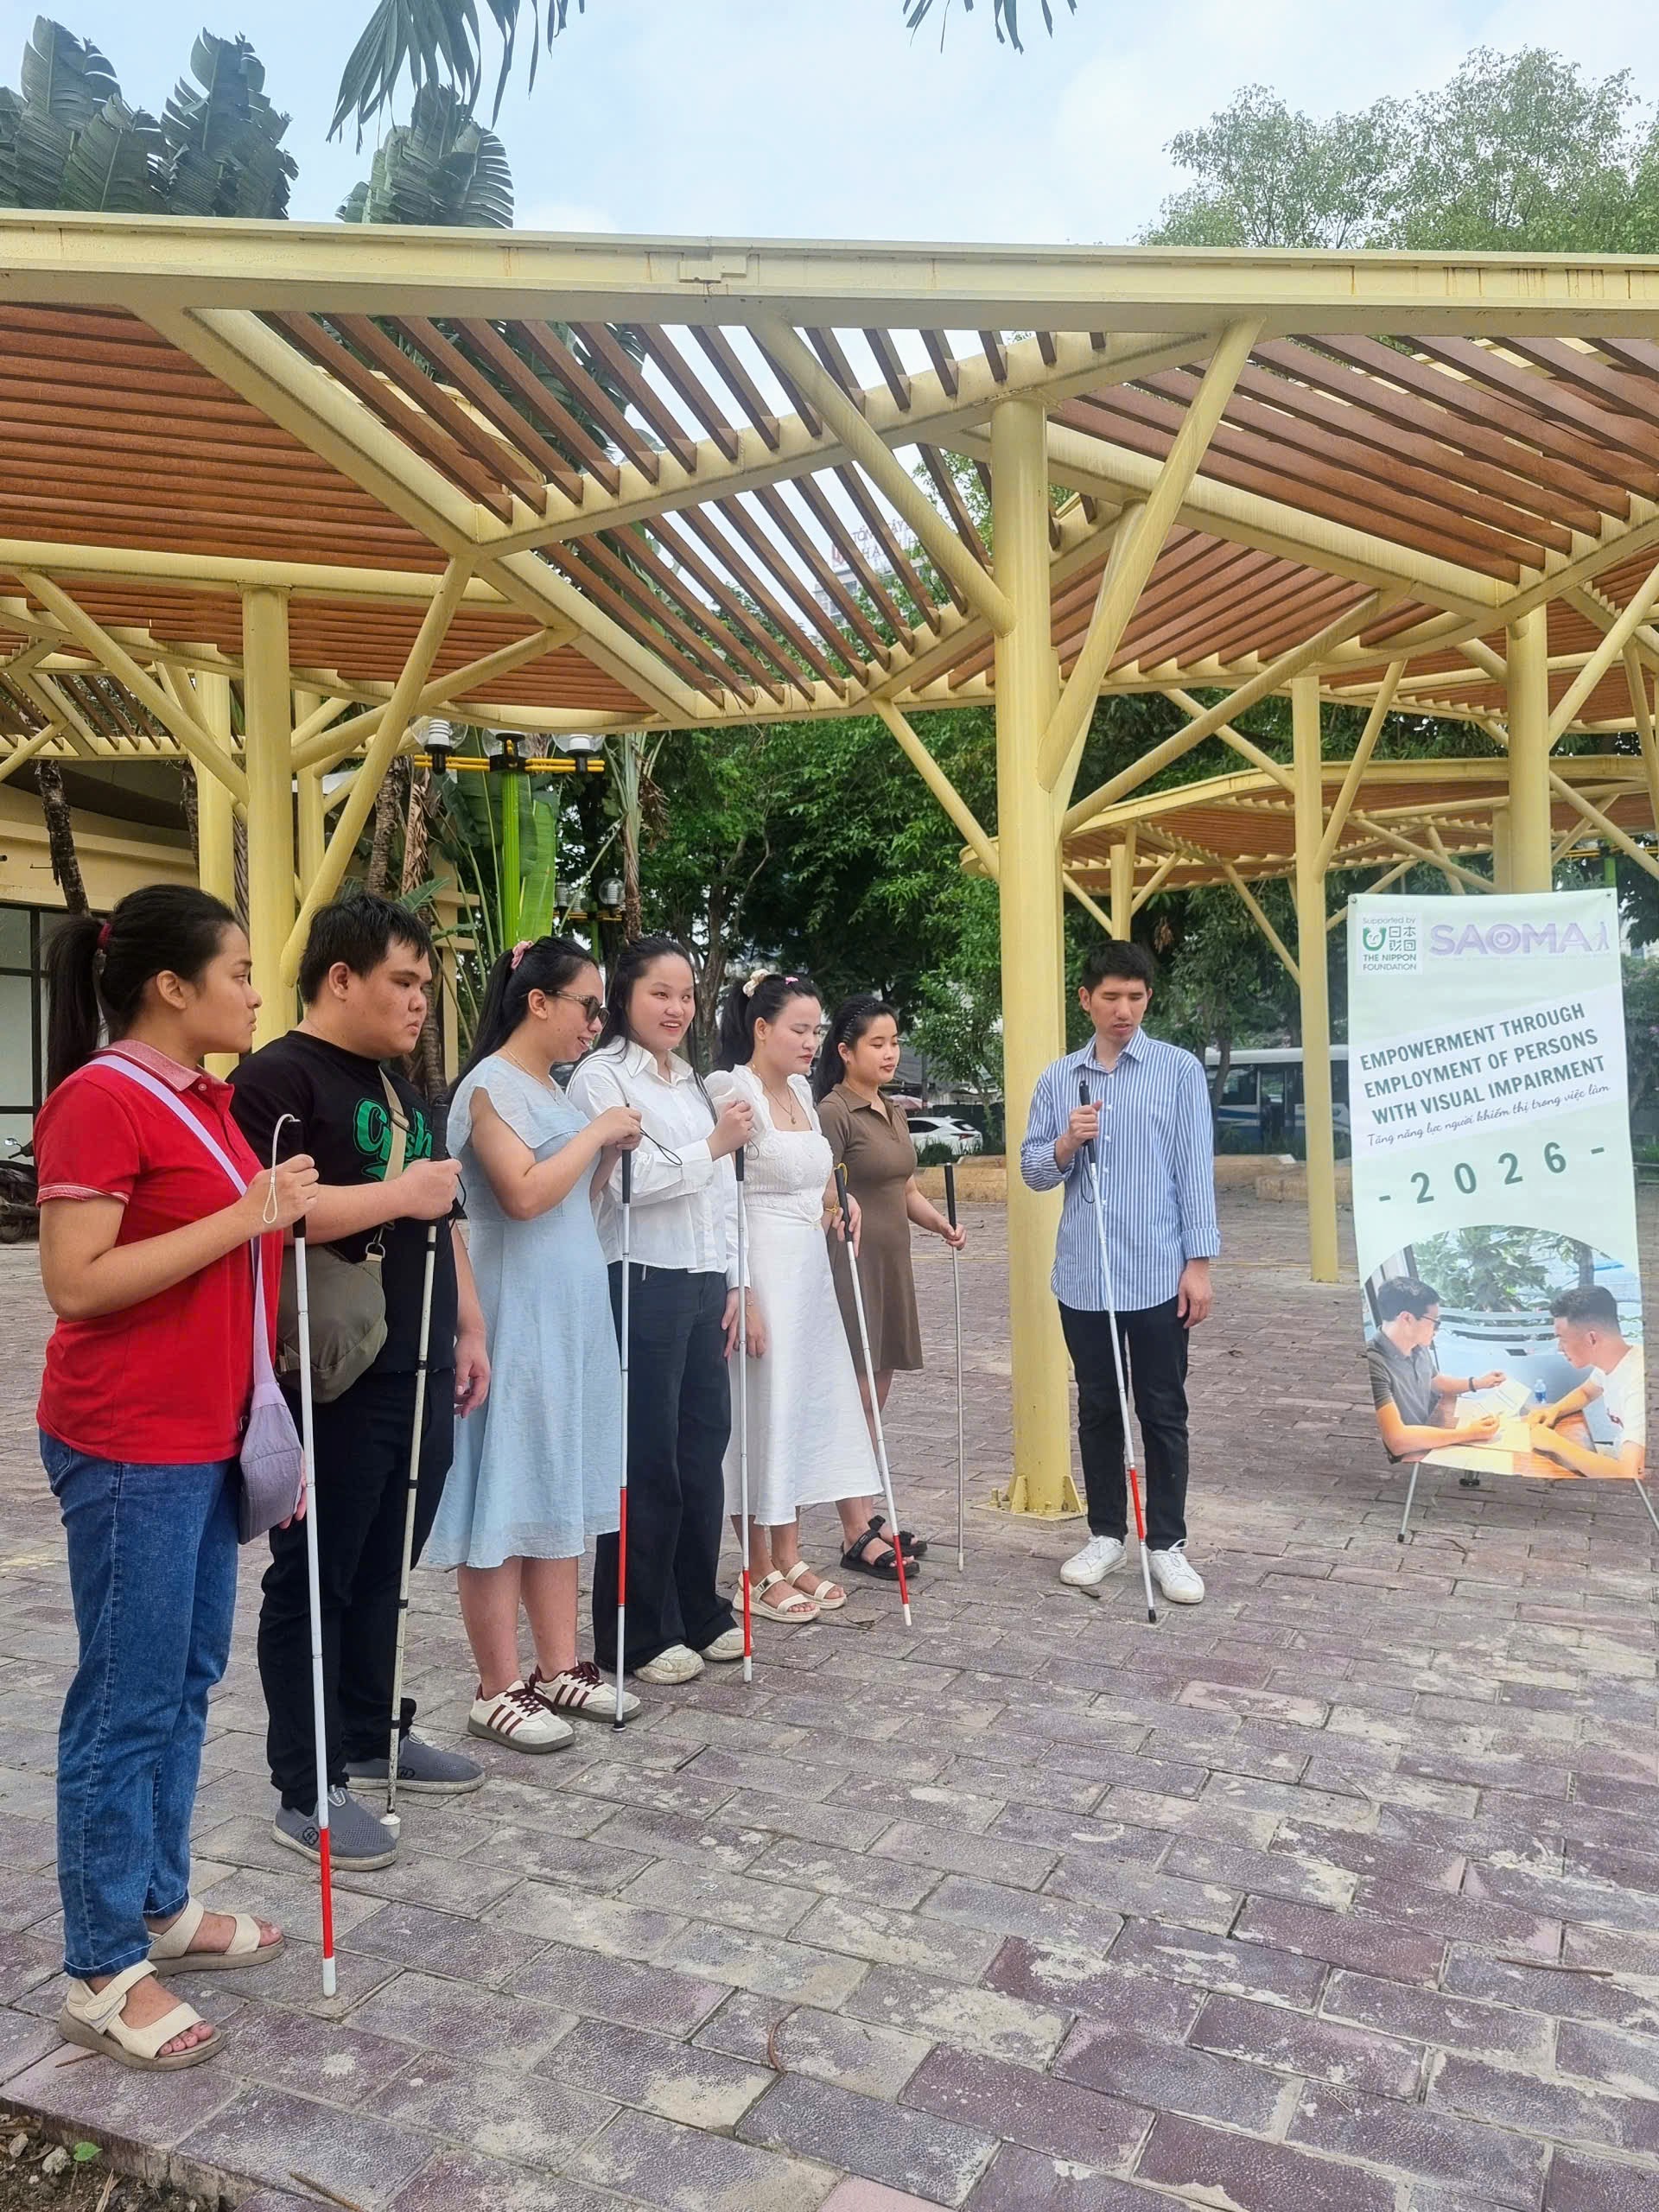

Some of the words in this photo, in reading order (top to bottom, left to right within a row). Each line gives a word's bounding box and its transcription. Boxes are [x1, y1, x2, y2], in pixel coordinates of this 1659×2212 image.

[1406, 916, 1416, 925] by
[1359, 1024, 1496, 1071] EMPOWERMENT
[1499, 1002, 1586, 1038] THROUGH
[1363, 1056, 1482, 1099] EMPLOYMENT
[1487, 1050, 1509, 1070] OF
[1513, 1028, 1599, 1064] PERSONS
[1367, 1133, 1395, 1147] Tăng
[1397, 1127, 1424, 1140] năng
[1445, 1115, 1474, 1132] người
[1476, 1105, 1510, 1122] khiếm
[1512, 1100, 1529, 1115] thị
[1531, 1094, 1561, 1109] trong
[1563, 1090, 1586, 1103] việc
[1588, 1083, 1610, 1096] làm
[1371, 1100, 1418, 1125] WITH
[1420, 1086, 1485, 1115] VISUAL
[1488, 1055, 1605, 1099] IMPAIRMENT
